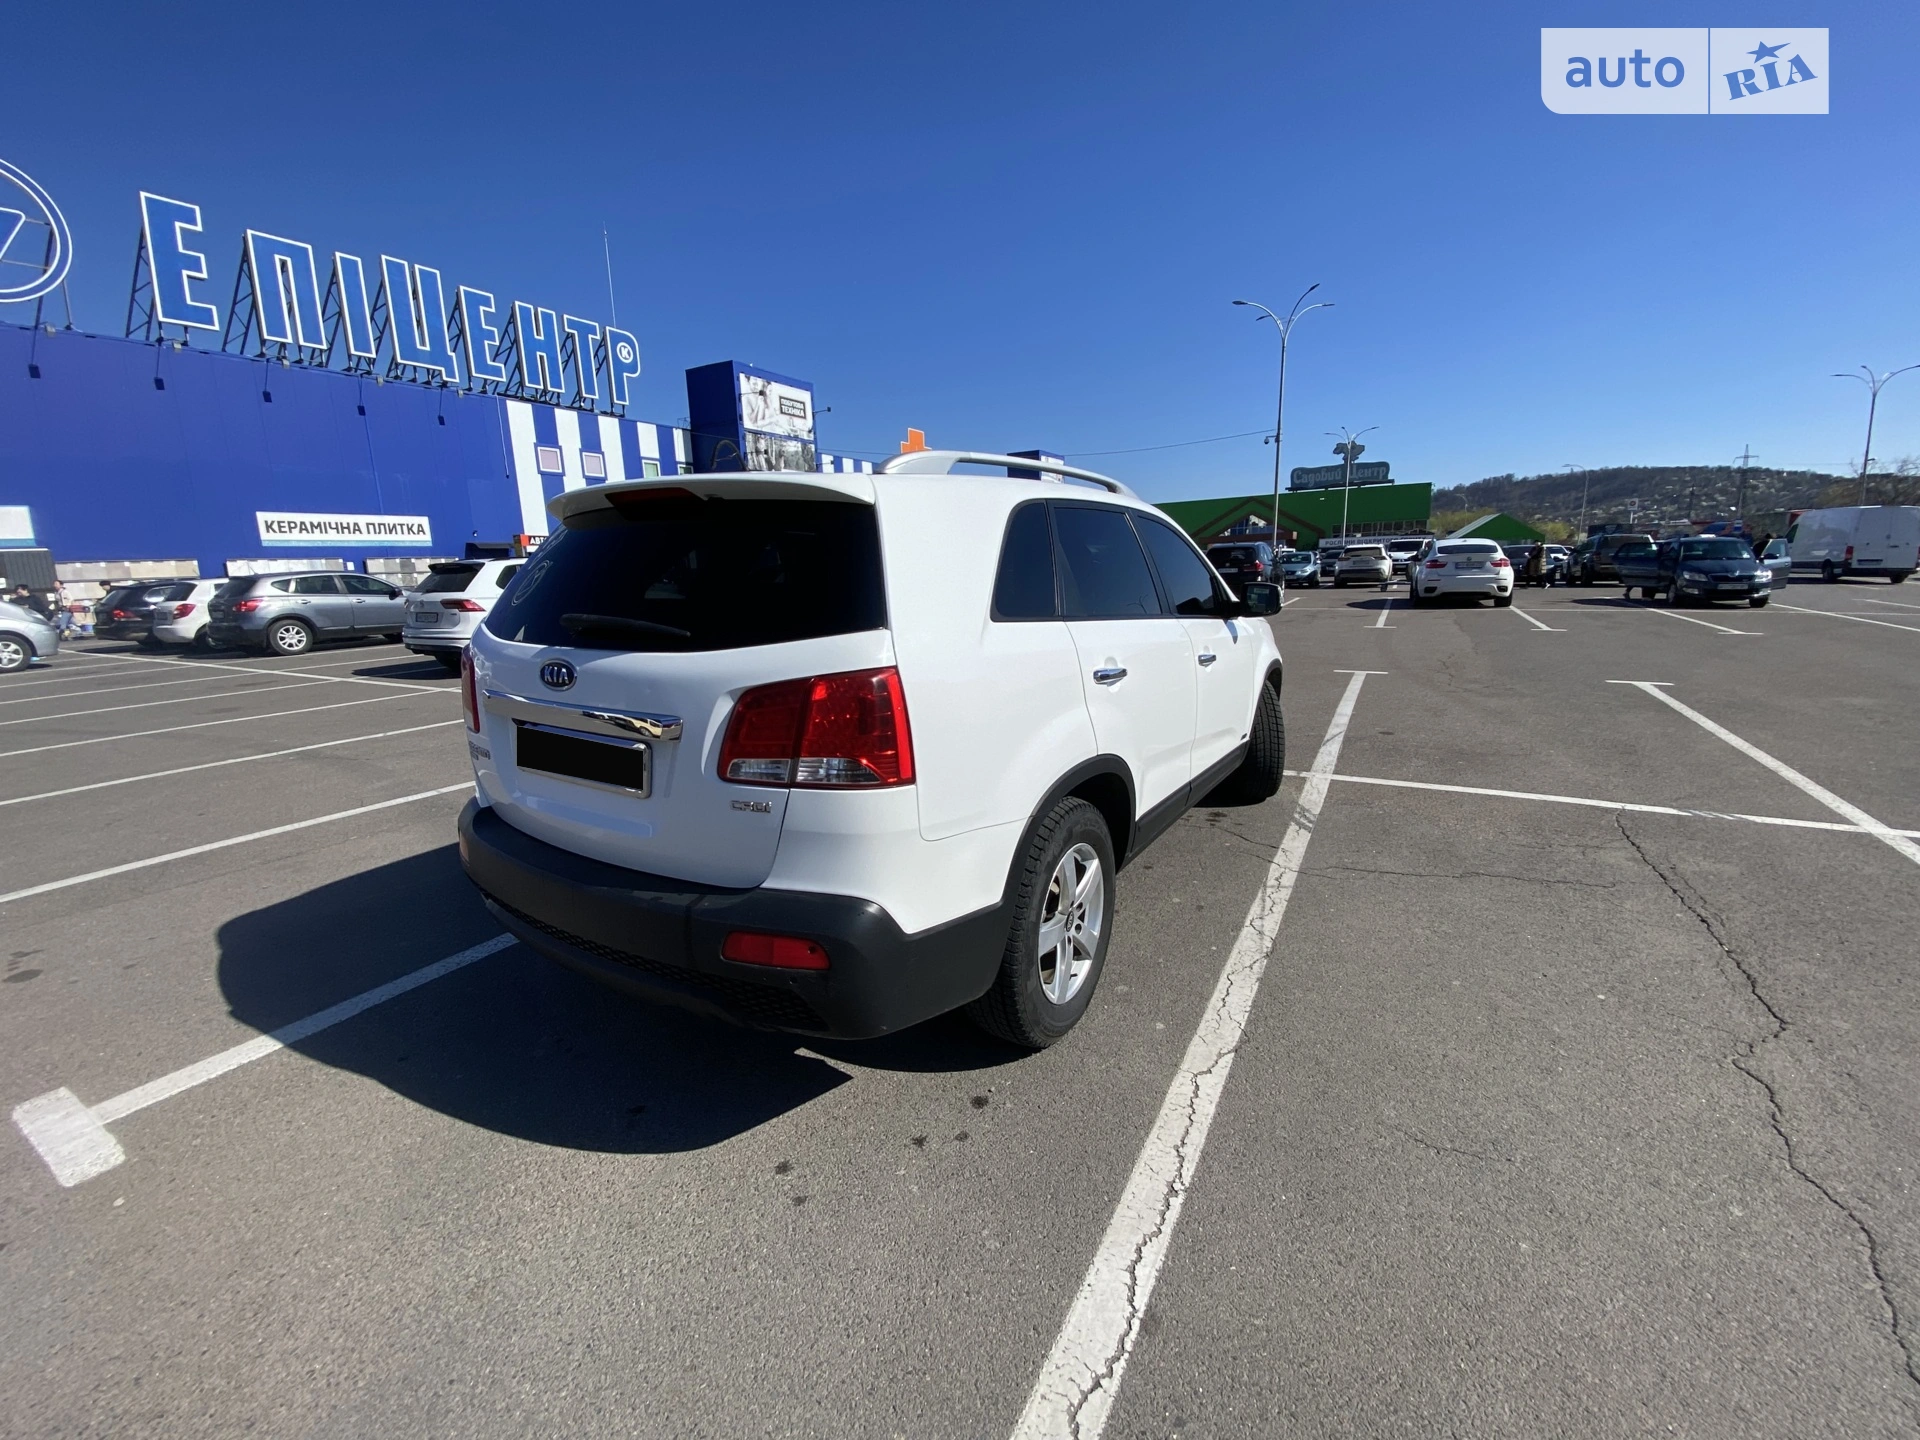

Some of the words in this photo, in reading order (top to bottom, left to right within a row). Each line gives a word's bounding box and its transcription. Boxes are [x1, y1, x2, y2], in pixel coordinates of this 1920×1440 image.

[139, 191, 641, 406] ЕПІЦЕНТР
[1293, 467, 1342, 487] Садовий
[264, 520, 363, 535] КЕРАМІЧНА
[366, 522, 427, 536] ПЛИТКА
[530, 536, 547, 545] АВТ
[544, 665, 570, 684] KIA
